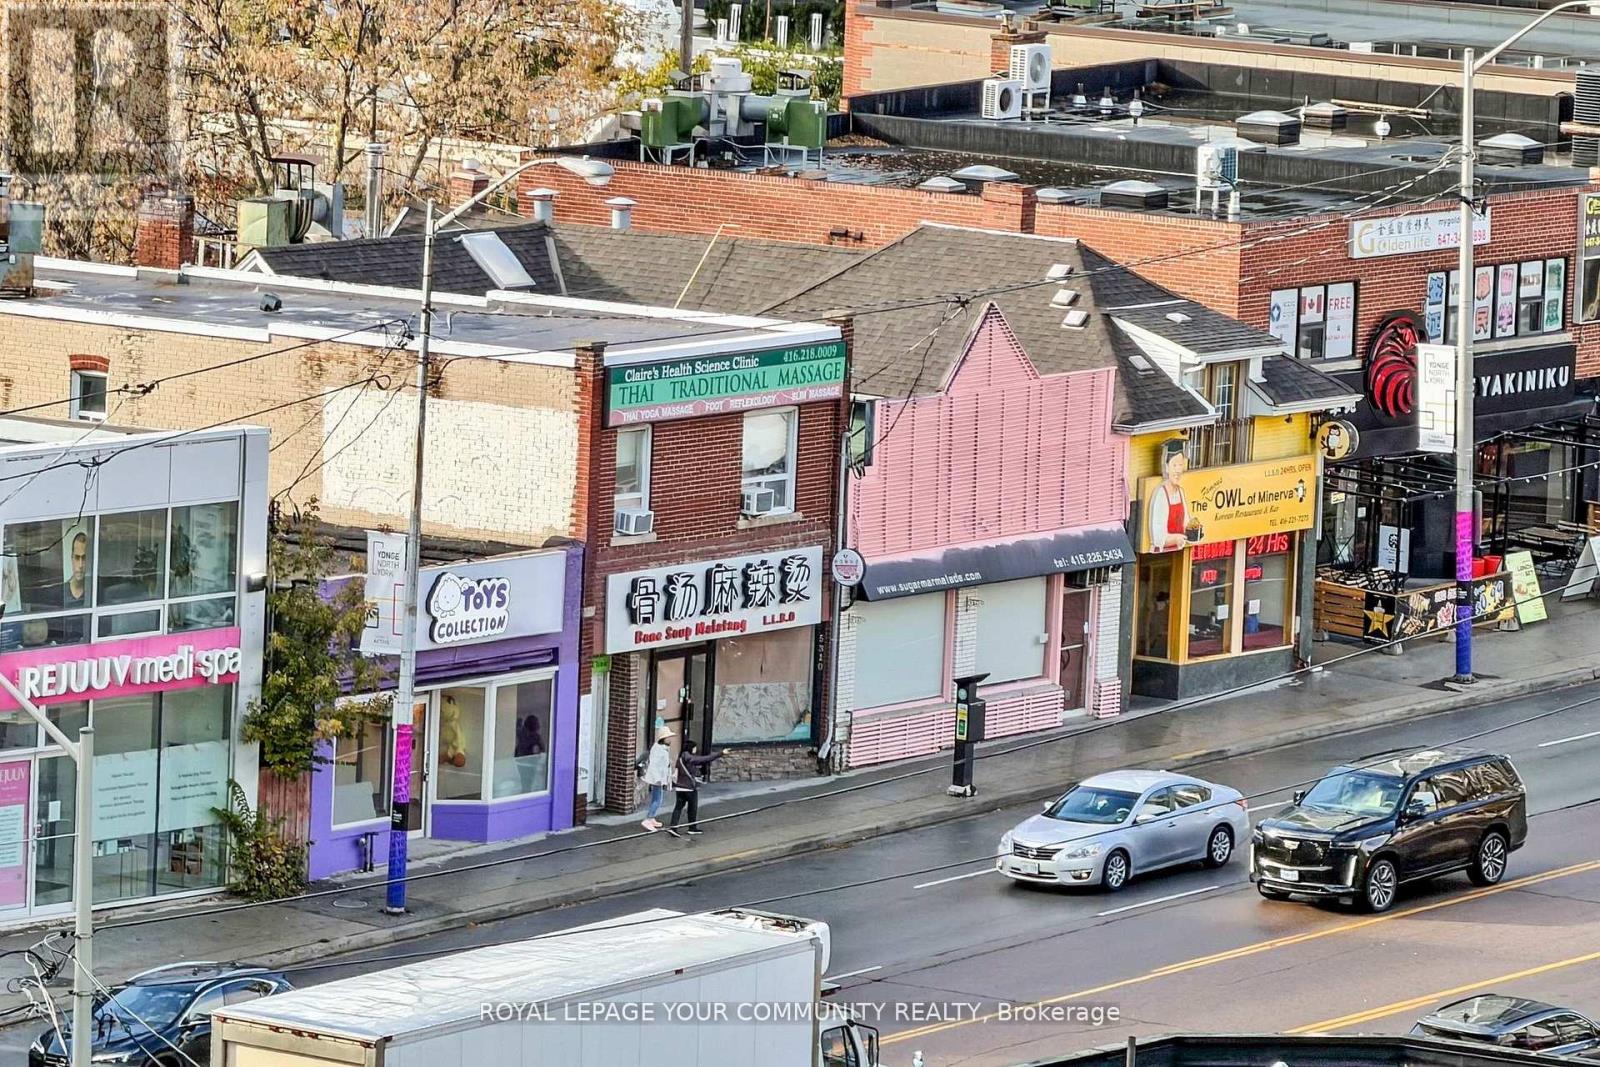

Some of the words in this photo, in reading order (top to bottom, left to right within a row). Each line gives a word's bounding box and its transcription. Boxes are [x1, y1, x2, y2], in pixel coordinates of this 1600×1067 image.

[1329, 297, 1352, 310] FREE
[783, 346, 838, 363] 416.218.0009
[625, 366, 660, 382] Claire's
[662, 362, 694, 379] Health
[695, 358, 731, 374] Science
[732, 355, 760, 370] Clinic
[619, 385, 654, 405] THAI
[670, 373, 769, 400] TRADITIONAL
[777, 361, 842, 386] MASSAGE
[1481, 366, 1570, 397] YAKINIKU
[661, 403, 694, 417] MASSAGE
[1191, 500, 1208, 512] The
[1215, 488, 1246, 510] OWL
[1247, 493, 1257, 505] of
[1258, 488, 1294, 504] Minerva
[1235, 507, 1262, 519] Restaurant
[377, 550, 400, 561] YONGE
[1248, 536, 1265, 555] 24
[1053, 557, 1069, 569] tel:
[1070, 548, 1124, 566] 416.226.5434
[629, 555, 811, 626] 骨汤麻辣烫
[877, 572, 982, 595] www.sugarmarmalade.com
[461, 582, 508, 612] TOYS
[437, 616, 506, 639] COLLECTION
[634, 630, 662, 645] Bone
[664, 625, 692, 641] Soup
[20, 655, 131, 699] REJUUV
[130, 645, 195, 685] medi
[195, 646, 241, 685] spa
[0, 766, 26, 784] EJUUV
